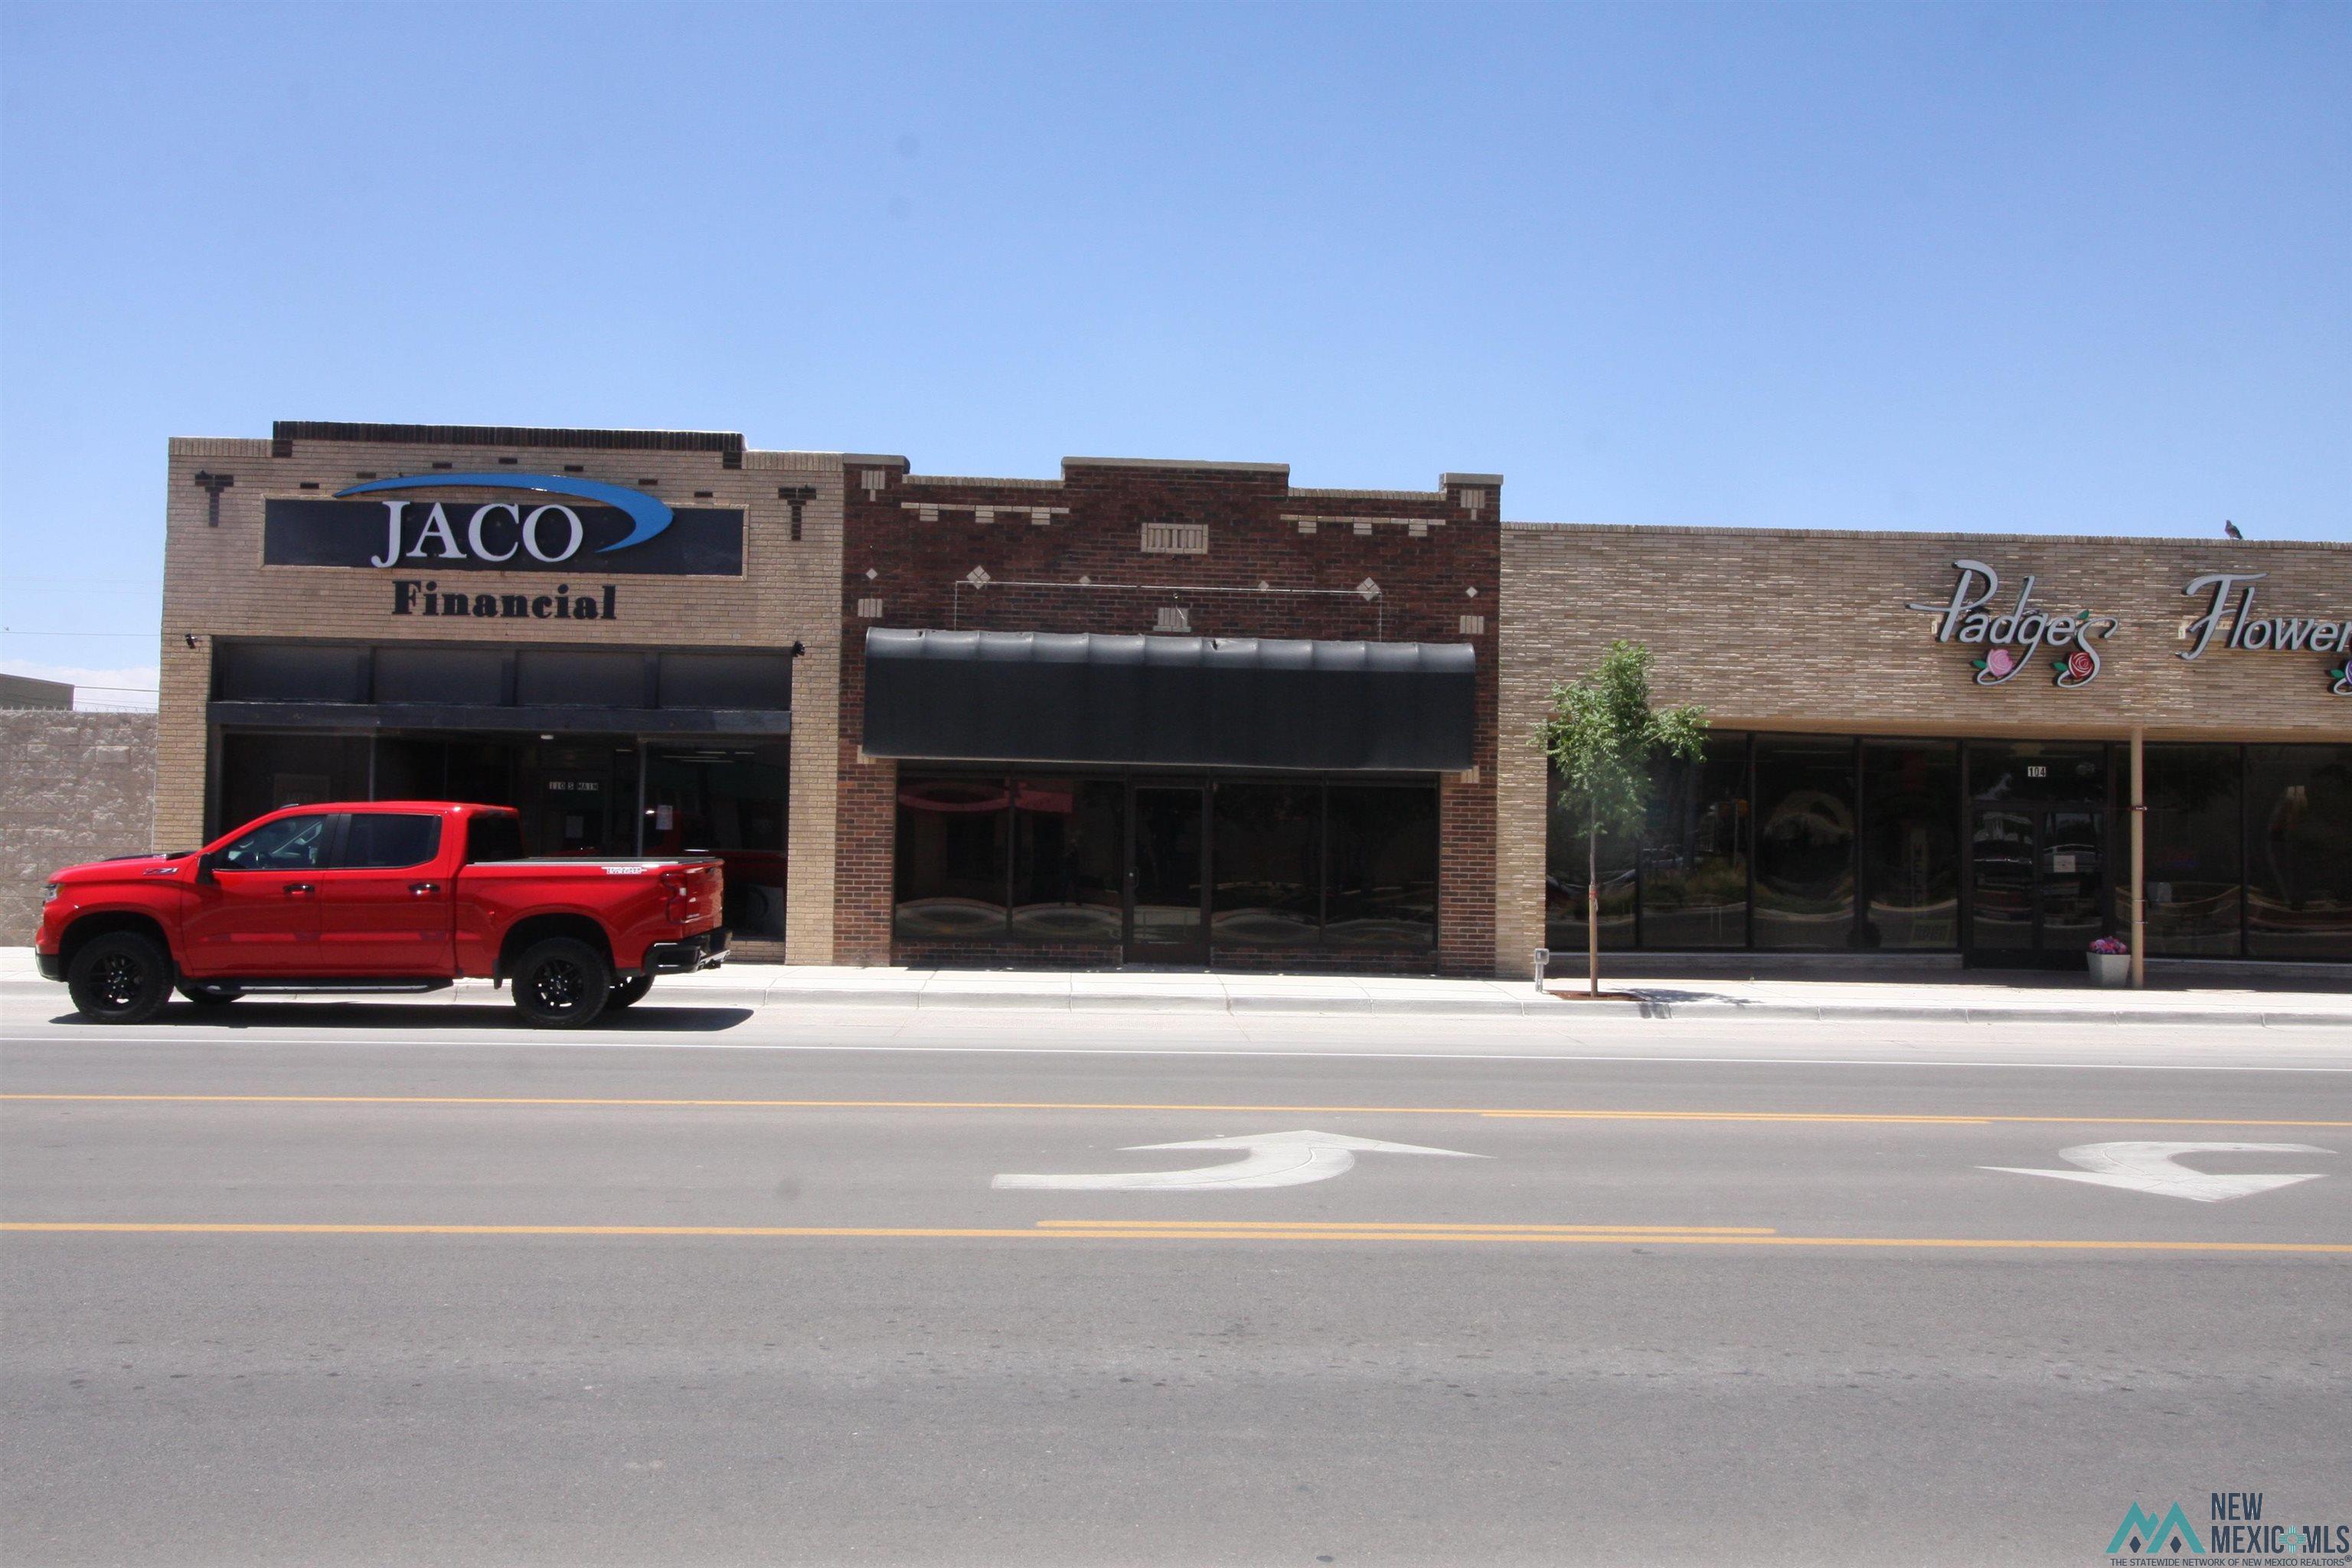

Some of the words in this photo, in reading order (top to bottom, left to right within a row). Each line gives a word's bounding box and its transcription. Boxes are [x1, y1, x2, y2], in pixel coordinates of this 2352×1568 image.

[371, 500, 583, 569] JACO
[391, 580, 618, 620] Financial
[2175, 573, 2352, 695] Flower
[2028, 766, 2047, 777] 104
